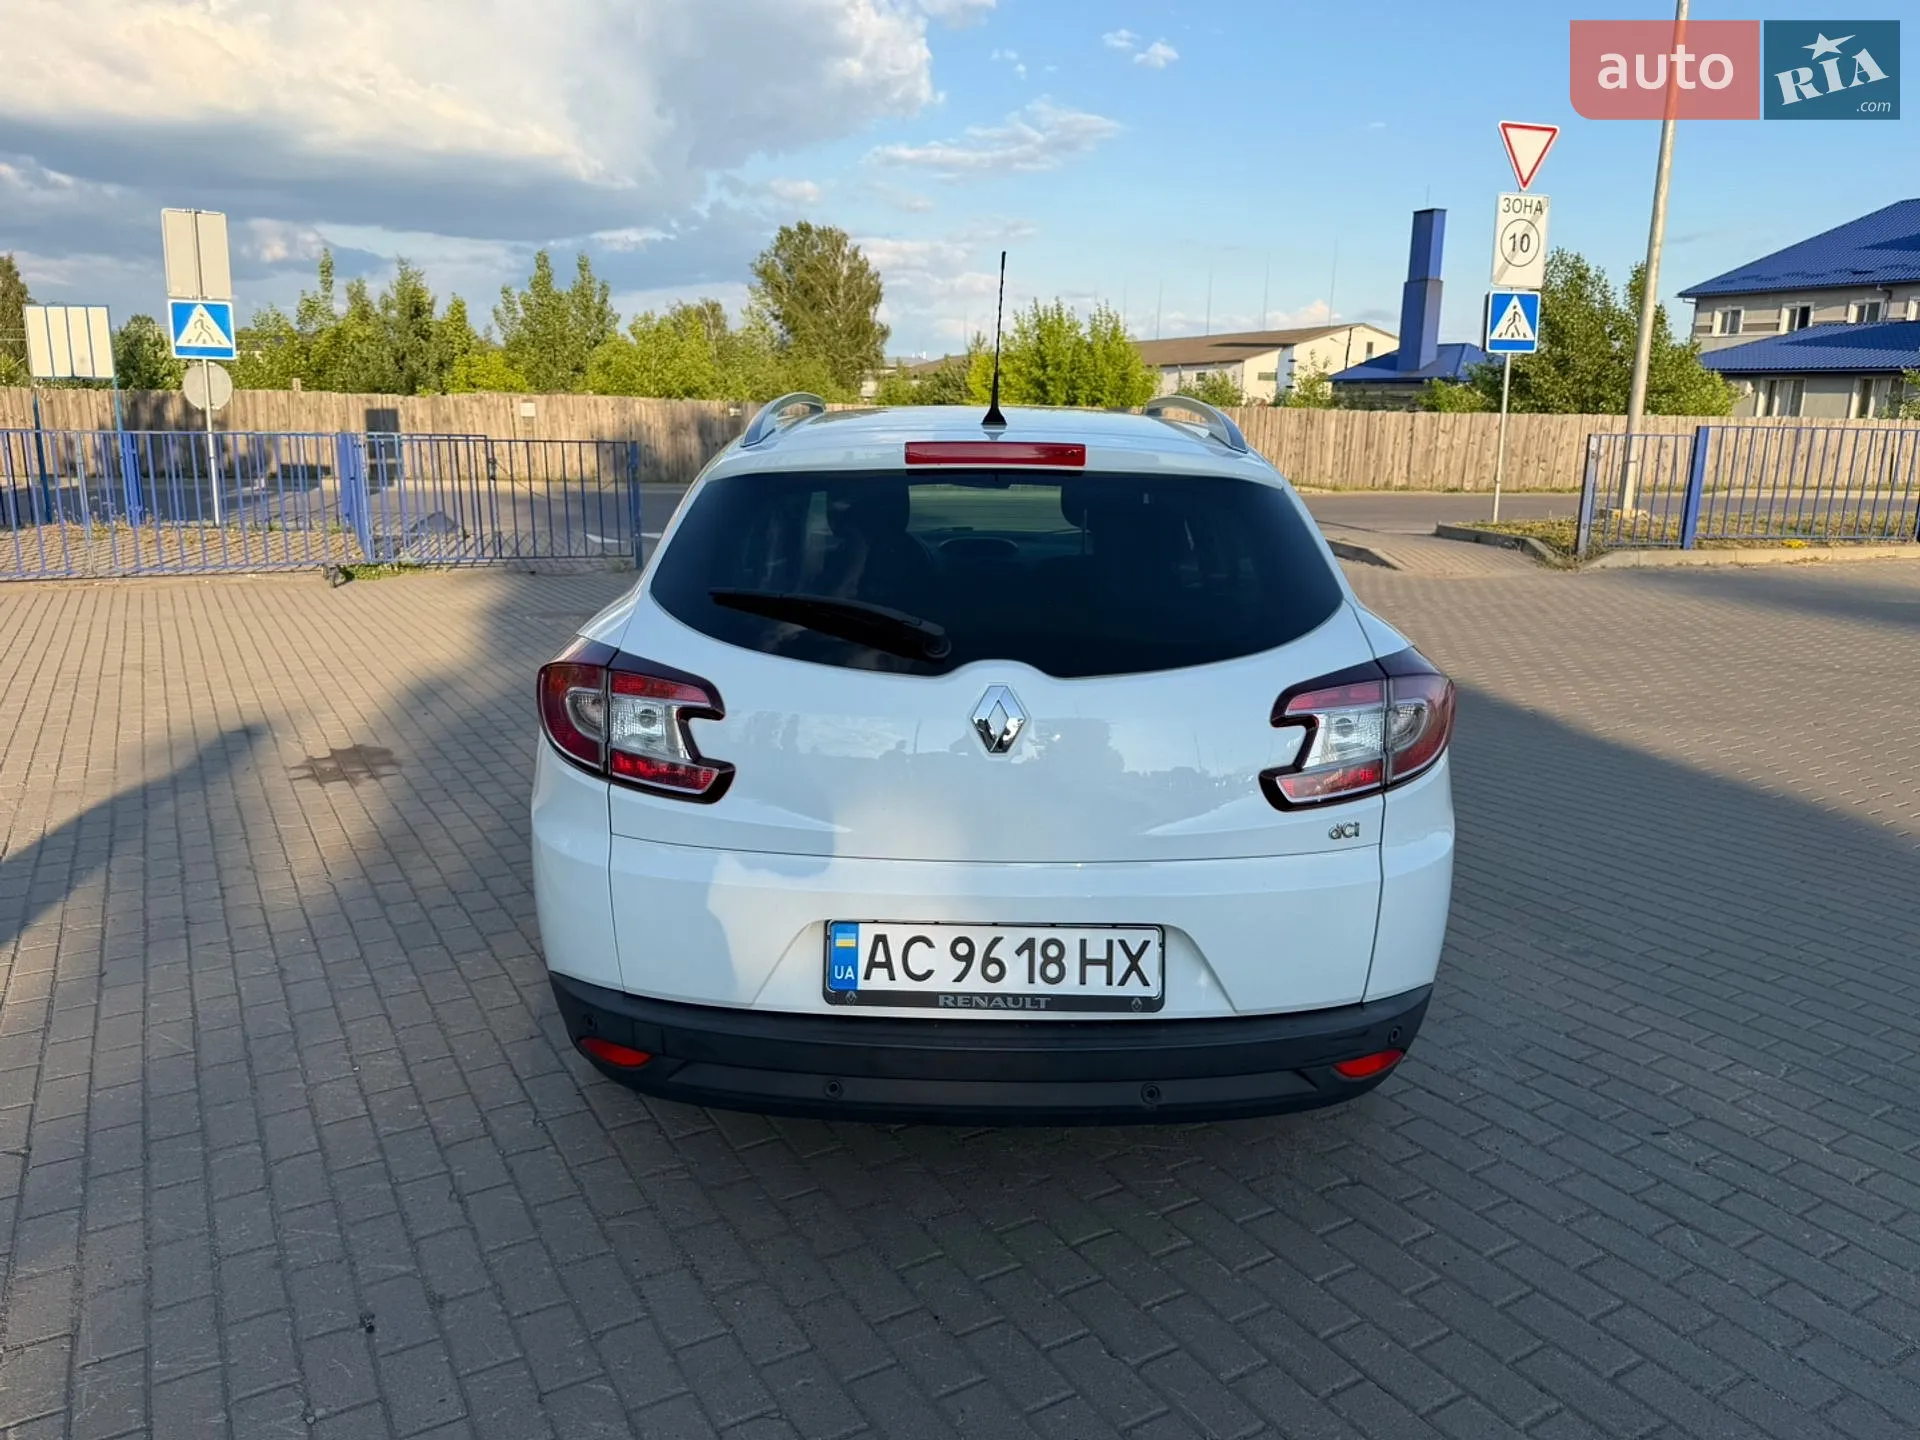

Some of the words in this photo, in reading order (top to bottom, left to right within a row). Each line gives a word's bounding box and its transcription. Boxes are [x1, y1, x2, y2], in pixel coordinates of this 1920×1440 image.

[1502, 197, 1544, 216] ЗОНА
[1508, 232, 1531, 253] 10
[863, 933, 936, 983] AC
[949, 935, 1067, 985] 9618
[1078, 937, 1151, 987] HX
[834, 965, 856, 980] UA
[938, 994, 1051, 1010] RENAULT
